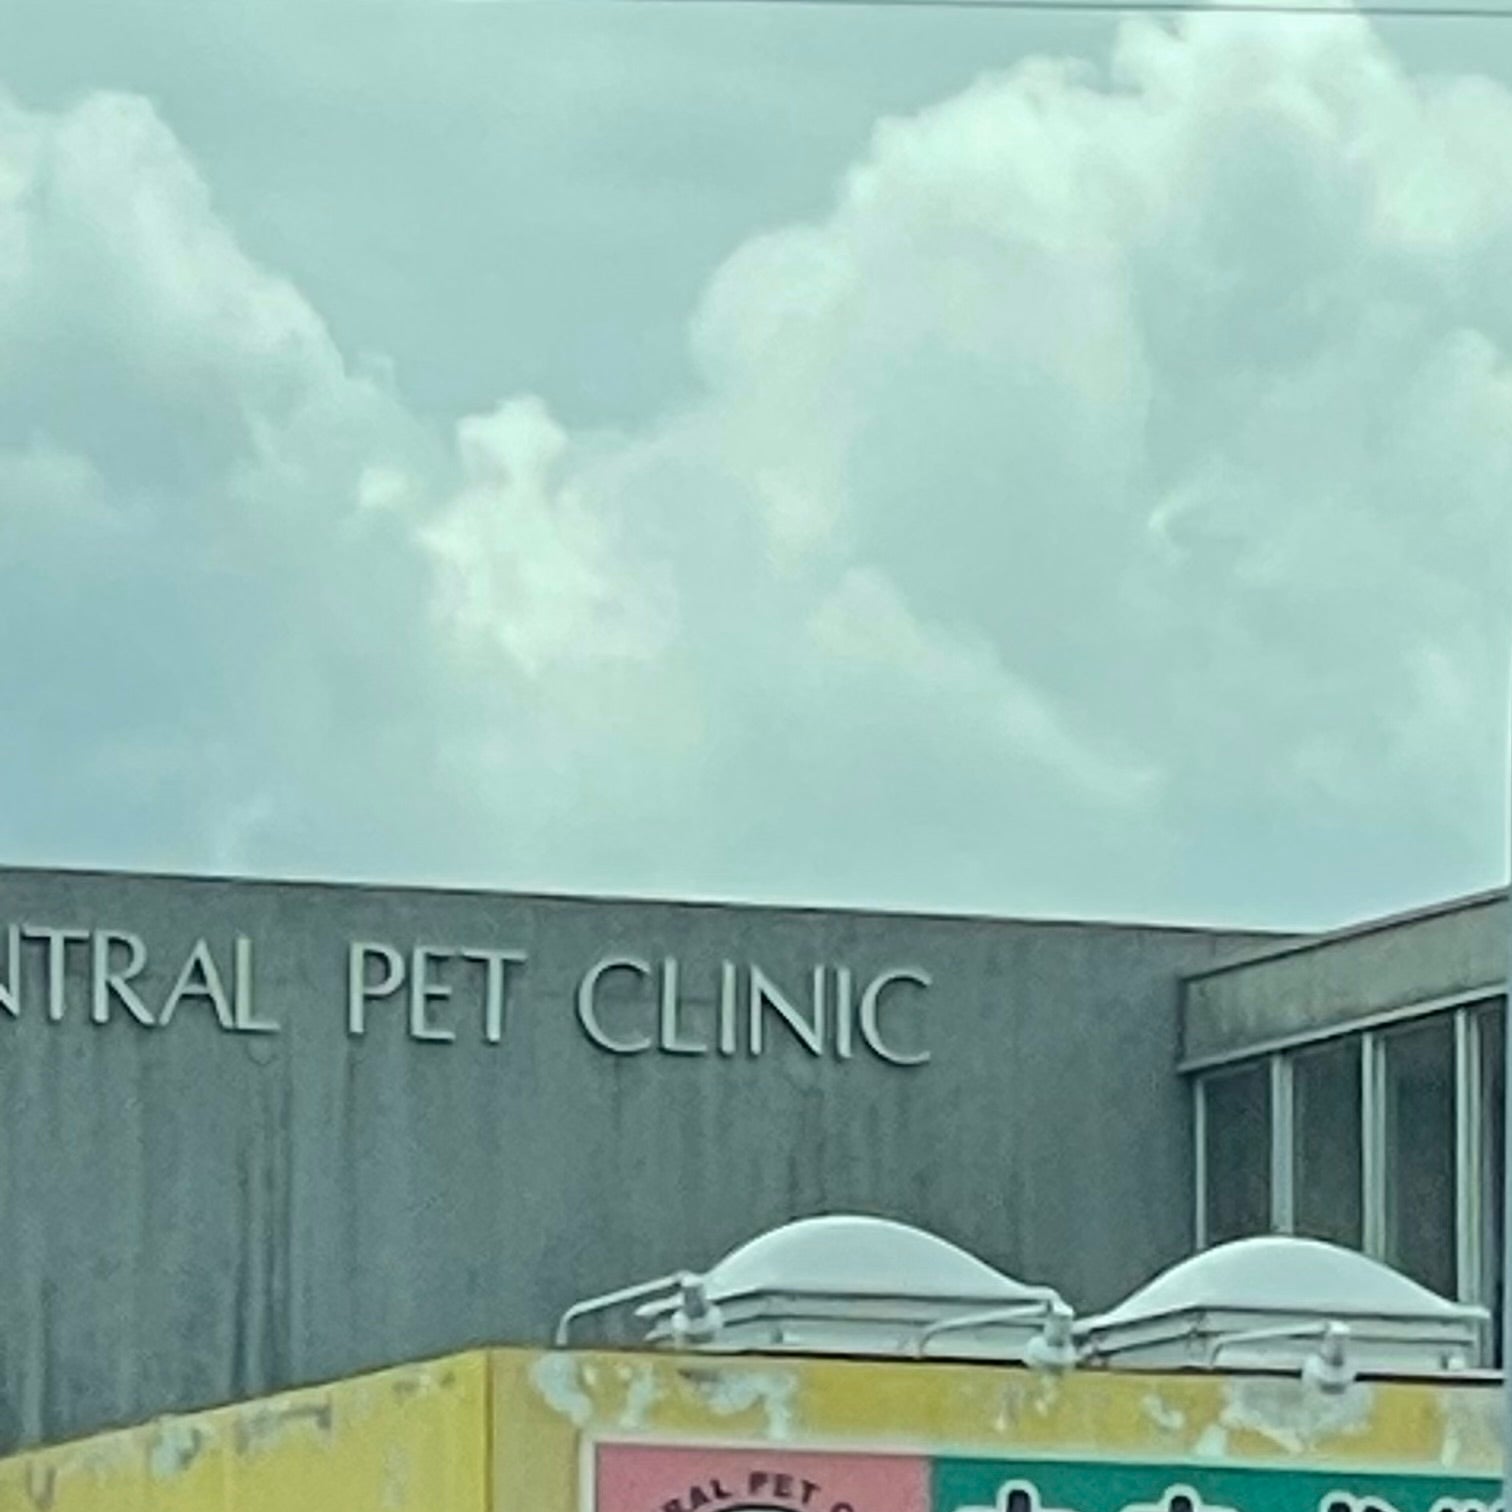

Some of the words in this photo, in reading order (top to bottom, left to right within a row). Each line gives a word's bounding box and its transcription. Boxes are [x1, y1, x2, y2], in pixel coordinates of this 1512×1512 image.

[0, 922, 281, 1032] TRAL
[348, 943, 526, 1044] PET
[577, 957, 933, 1065] CLINIC
[748, 1470, 821, 1505] PET
